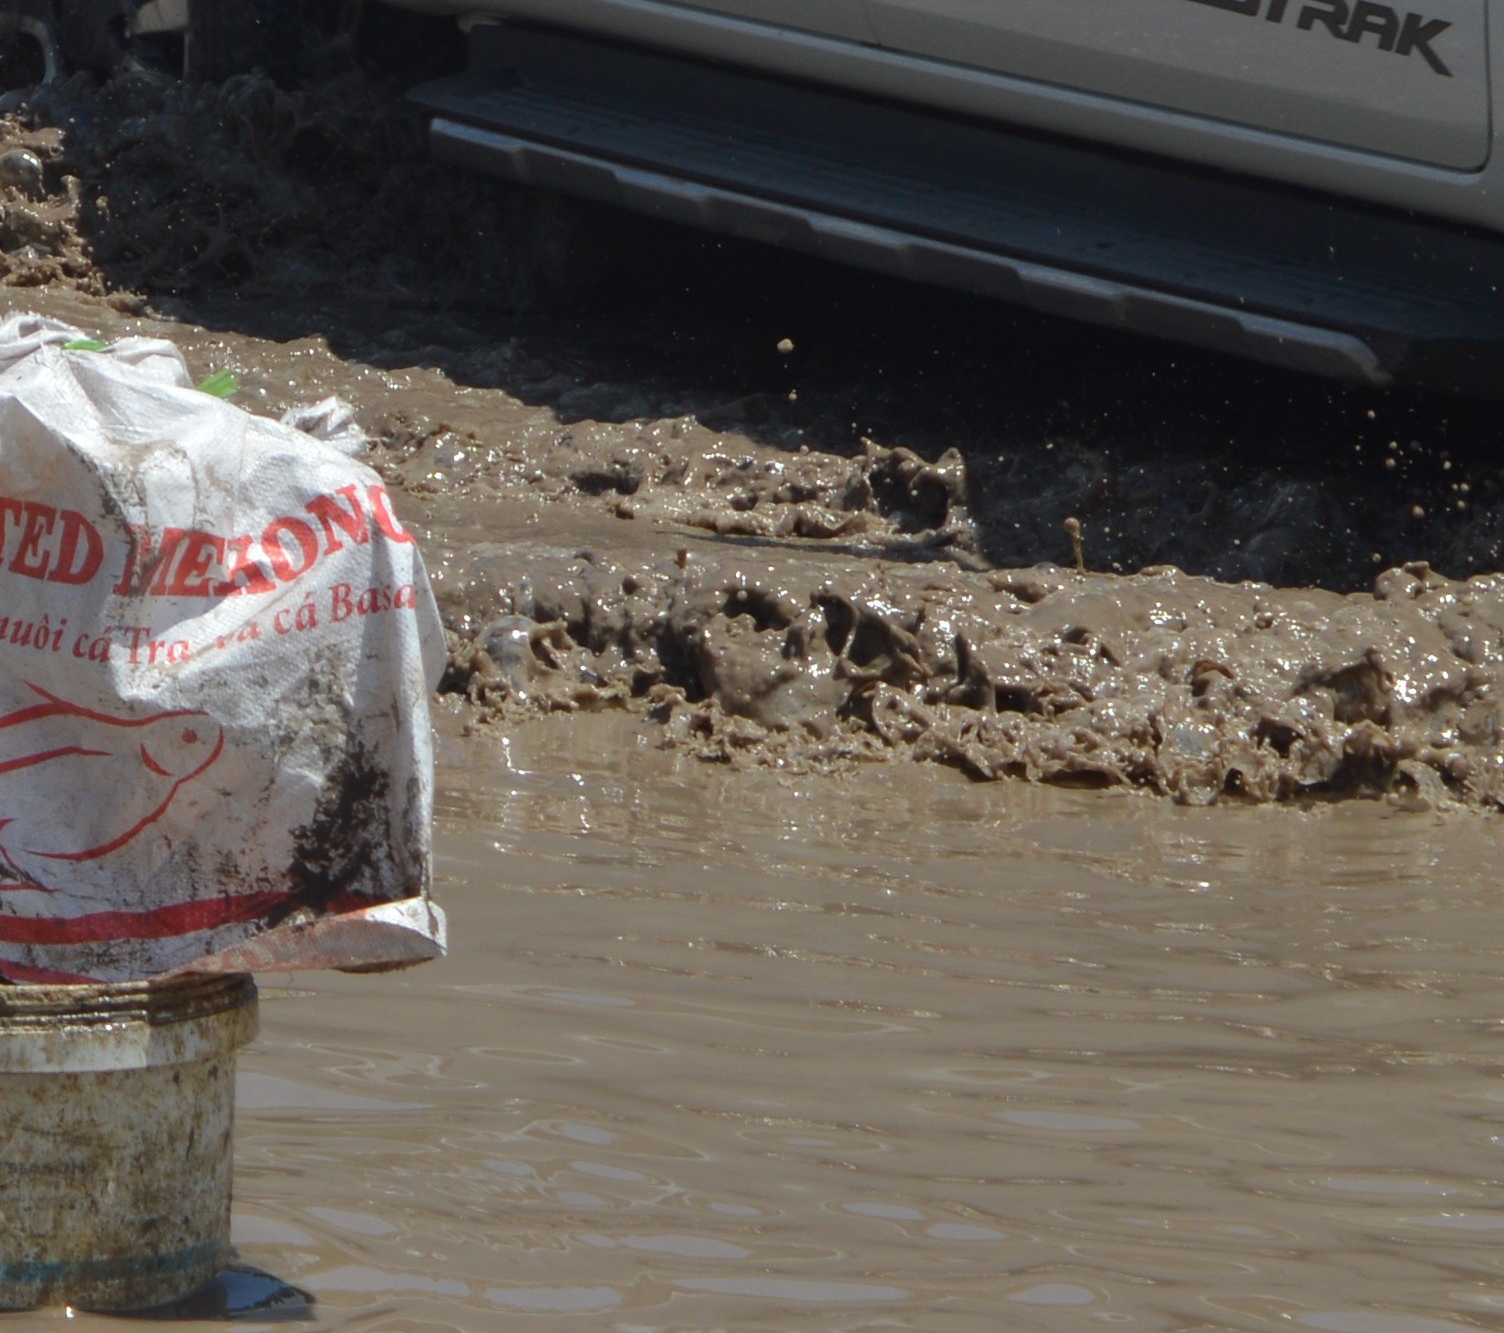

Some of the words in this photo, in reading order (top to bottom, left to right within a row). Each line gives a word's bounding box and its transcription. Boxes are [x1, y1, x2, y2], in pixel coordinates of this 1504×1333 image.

[72, 624, 115, 664] cá
[123, 626, 191, 666] Tra
[273, 590, 320, 636] cá
[330, 580, 417, 627] Basa
